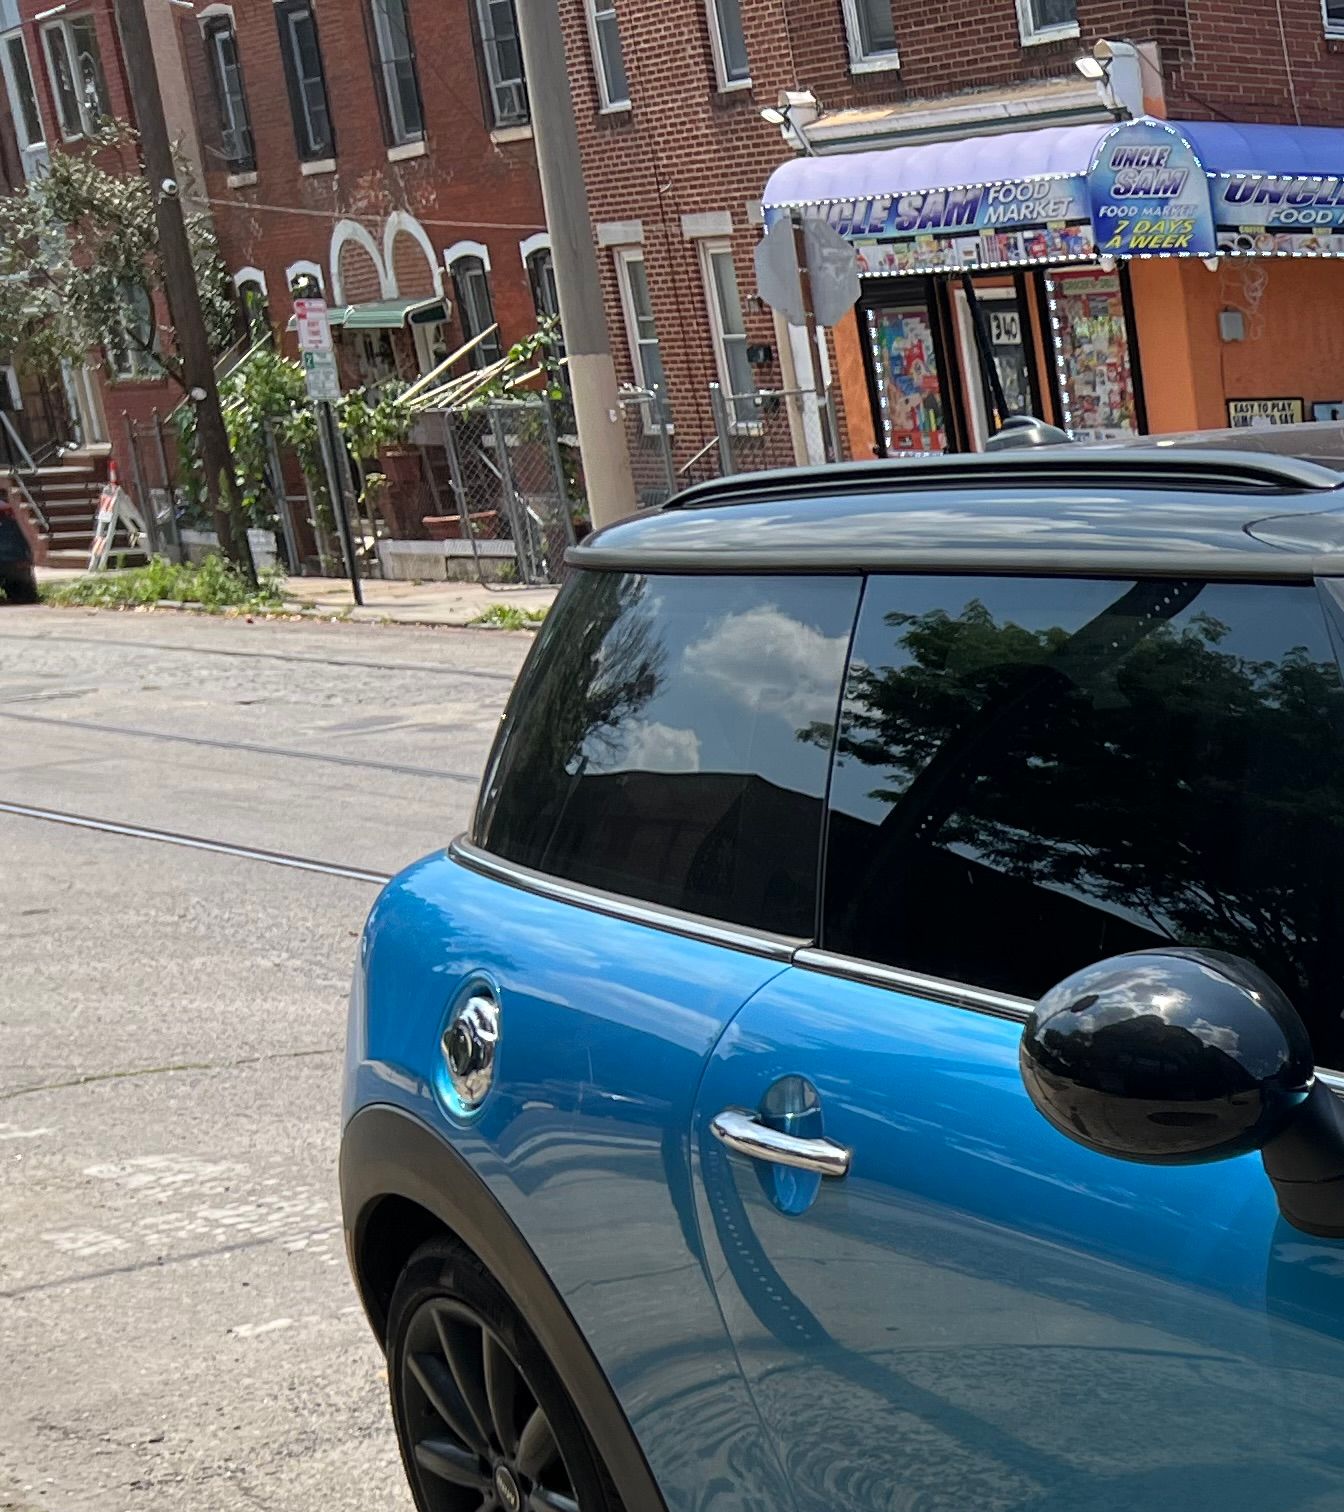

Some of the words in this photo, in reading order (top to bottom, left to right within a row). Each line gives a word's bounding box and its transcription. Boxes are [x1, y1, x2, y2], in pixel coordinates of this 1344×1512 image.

[1111, 146, 1171, 171] UNCLE
[987, 179, 1050, 206] FOOD
[1111, 168, 1188, 199] SAM
[895, 185, 984, 232] SAM
[983, 197, 1074, 225] MARKET
[1098, 205, 1139, 219] FOOD
[1141, 204, 1199, 218] MARKET
[1267, 209, 1332, 225] FOOD
[1113, 219, 1131, 235] 7
[1133, 219, 1196, 234] DAYS
[1104, 234, 1122, 249] A
[1128, 233, 1195, 249] WEEK
[991, 314, 1017, 341] 340
